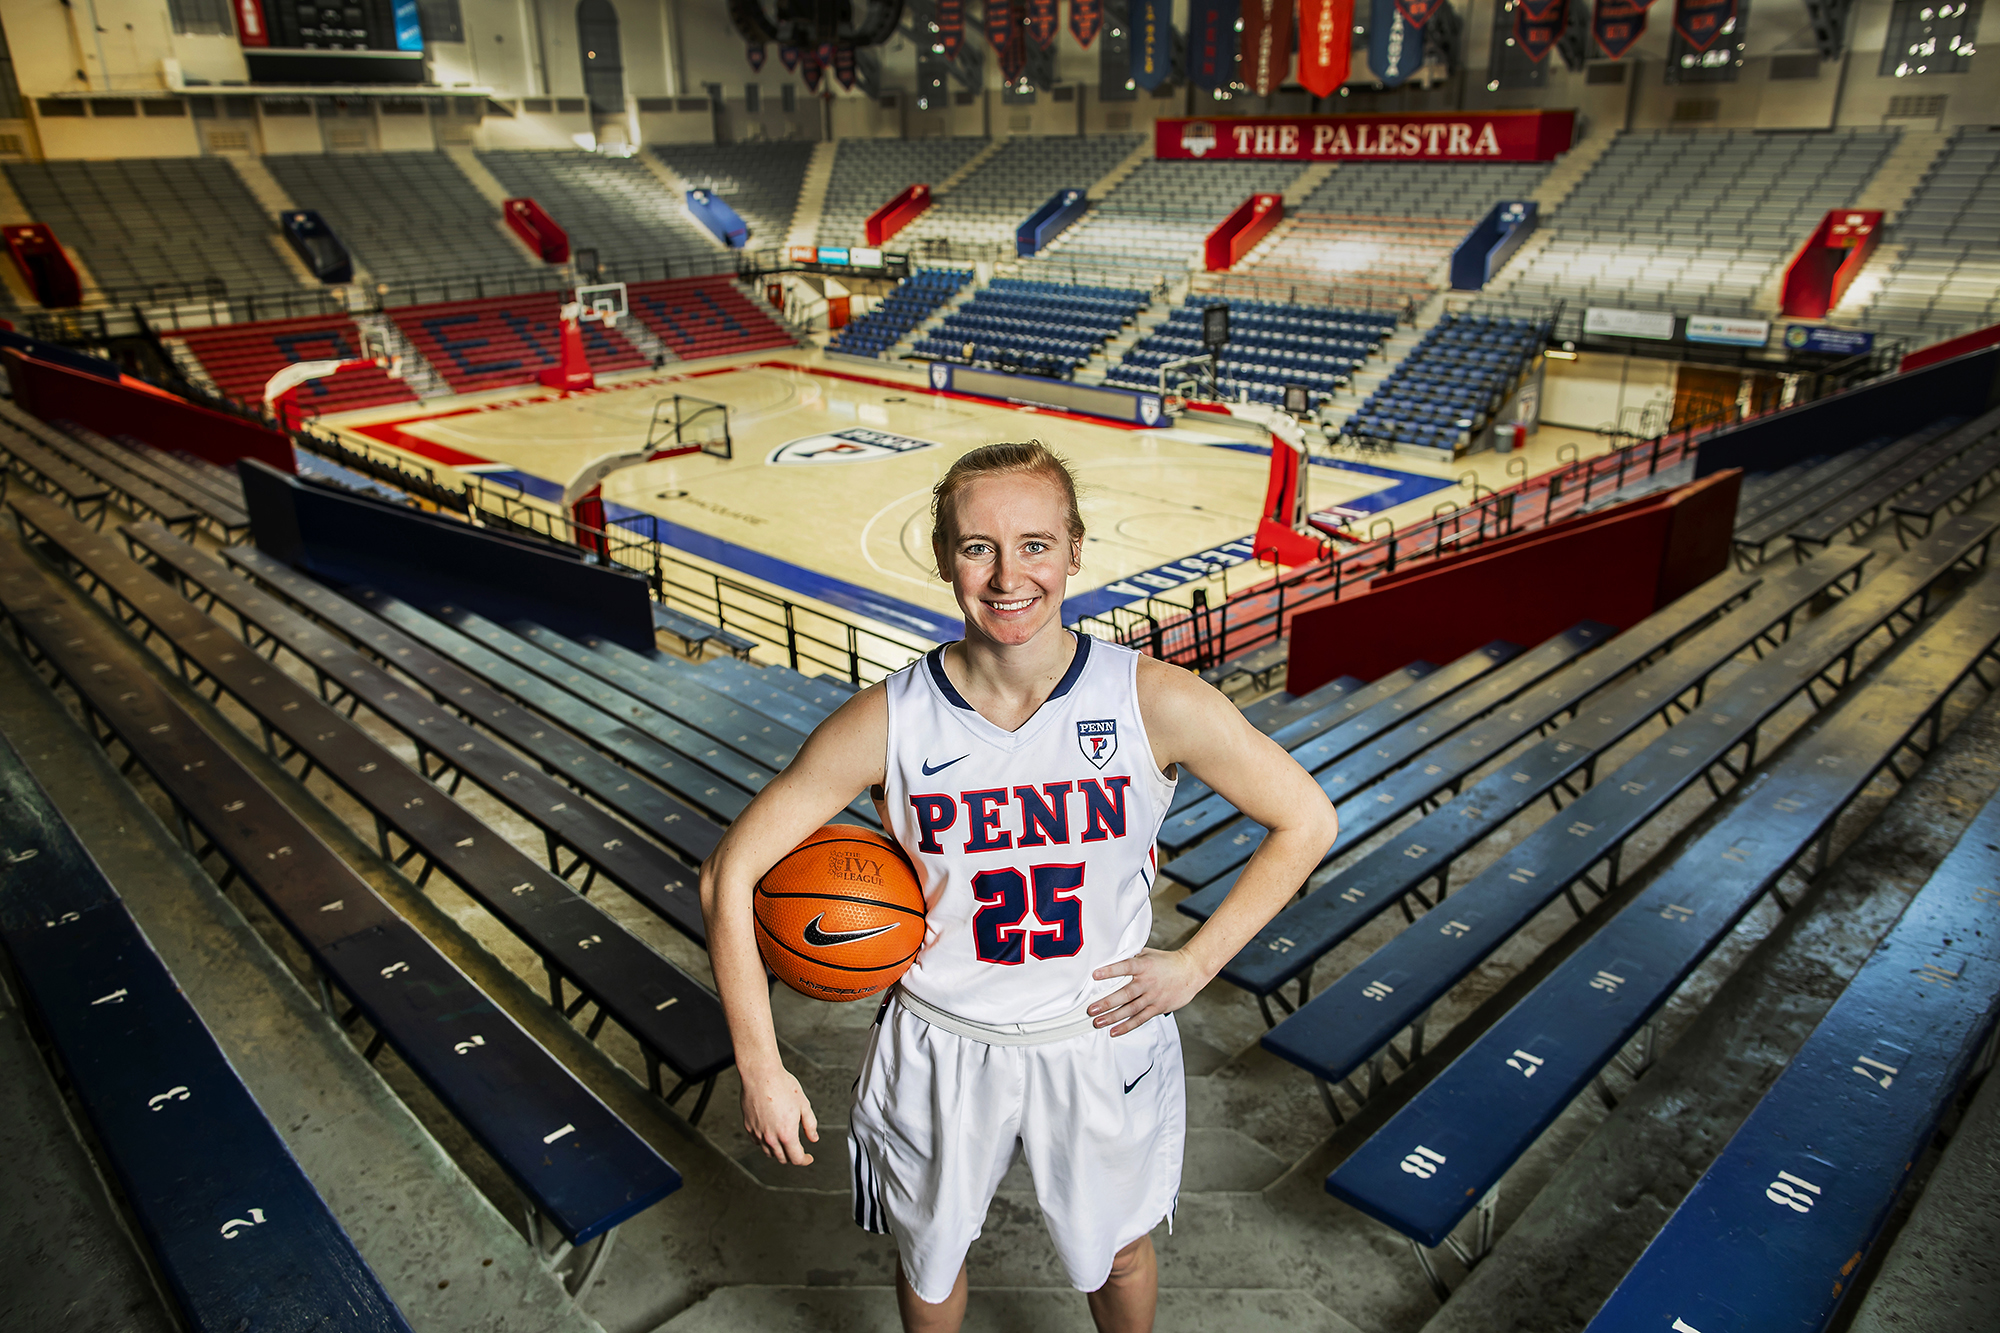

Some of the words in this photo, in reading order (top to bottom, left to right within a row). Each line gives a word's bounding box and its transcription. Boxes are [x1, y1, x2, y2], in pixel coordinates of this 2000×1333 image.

[1232, 124, 1300, 155] THE
[1310, 122, 1501, 156] PALESTRA
[845, 430, 918, 450] PENN
[1079, 721, 1115, 734] PENN
[1090, 737, 1108, 760] P
[909, 775, 1131, 855] PENN
[268, 846, 292, 860] 5
[603, 839, 622, 850] 3
[844, 851, 861, 859] THE
[1722, 848, 1750, 862] 14
[843, 857, 885, 877] IVY
[1508, 868, 1536, 884] 14
[664, 880, 682, 892] 2
[843, 872, 884, 887] LEAGUE
[512, 882, 534, 896] 3
[1341, 888, 1365, 902] 14
[321, 900, 344, 912] 4
[970, 861, 1086, 966] 25
[1660, 904, 1694, 922] 15
[46, 912, 80, 927] 5
[1440, 920, 1470, 938] 15
[578, 936, 602, 949] 2
[1269, 938, 1296, 952] 15
[380, 962, 410, 978] 3
[1590, 970, 1624, 992] 16
[91, 988, 128, 1004] 4
[1362, 981, 1394, 1001] 16
[656, 998, 678, 1010] 1
[454, 1035, 485, 1054] 2
[1506, 1050, 1544, 1078] 17
[1852, 1056, 1898, 1089] 17
[148, 1086, 190, 1111] 3
[544, 1123, 576, 1144] 1
[1400, 1146, 1446, 1178] 18
[1766, 1171, 1820, 1212] 18
[220, 1208, 266, 1239] 2
